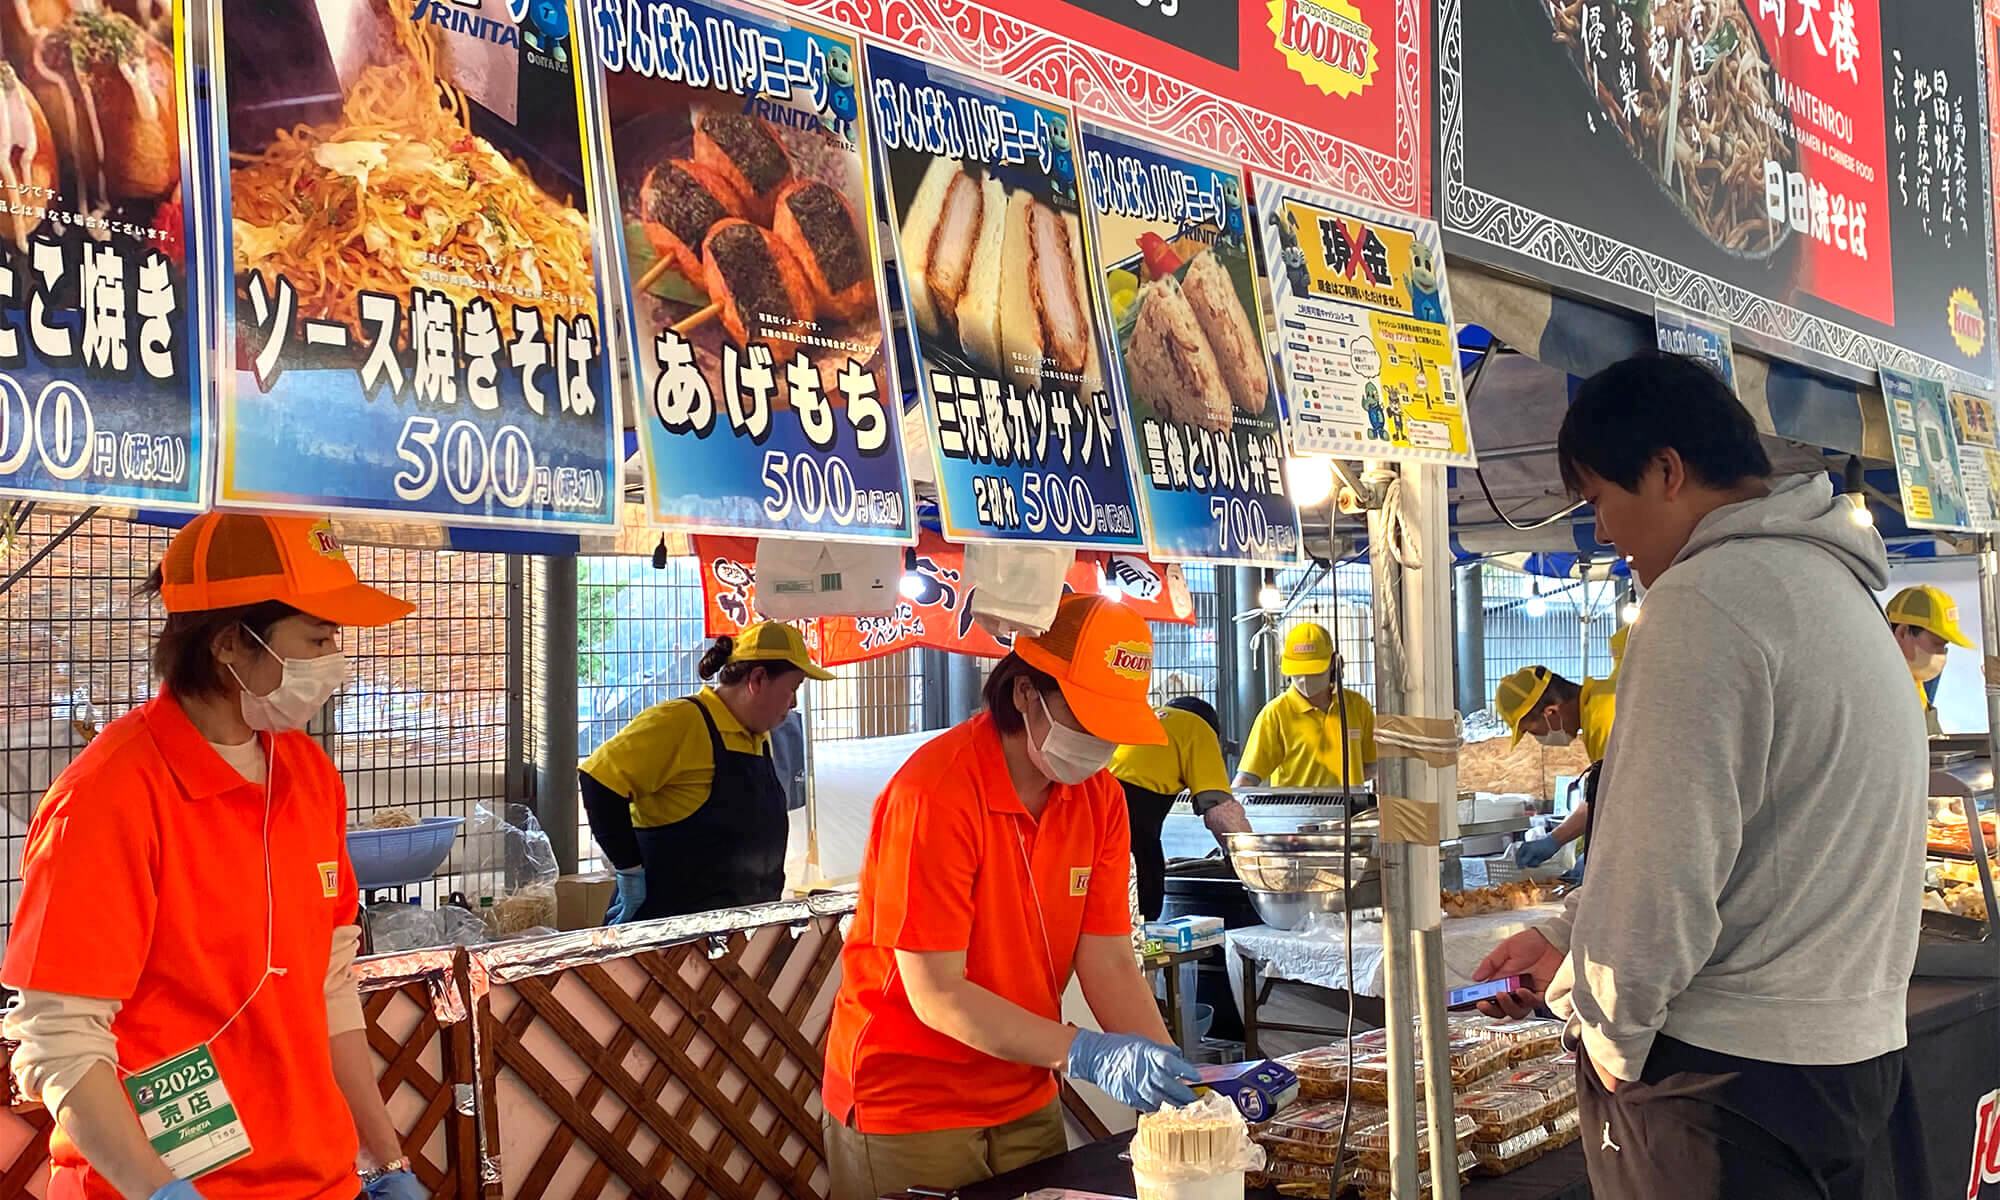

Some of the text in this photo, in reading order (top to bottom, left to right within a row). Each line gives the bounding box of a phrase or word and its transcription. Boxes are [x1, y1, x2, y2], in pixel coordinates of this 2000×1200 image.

[1774, 72, 1854, 145] MANTENROU
[1796, 126, 1822, 154] RAMEN
[1828, 145, 1856, 173] CHINESE
[1856, 160, 1875, 183] FOOD
[1763, 157, 1868, 260] 日田焼そば
[1317, 217, 1394, 288] 現金
[1317, 279, 1403, 308] 現金はご利用いただけません。
[247, 275, 598, 417] ソース焼きそば
[655, 332, 889, 451] あげもち
[930, 372, 1116, 468] 三元豚カツサンド
[1143, 418, 1285, 497] 豊後とりめし弁当
[153, 1058, 215, 1101] 2025
[157, 1089, 213, 1129] 売店
